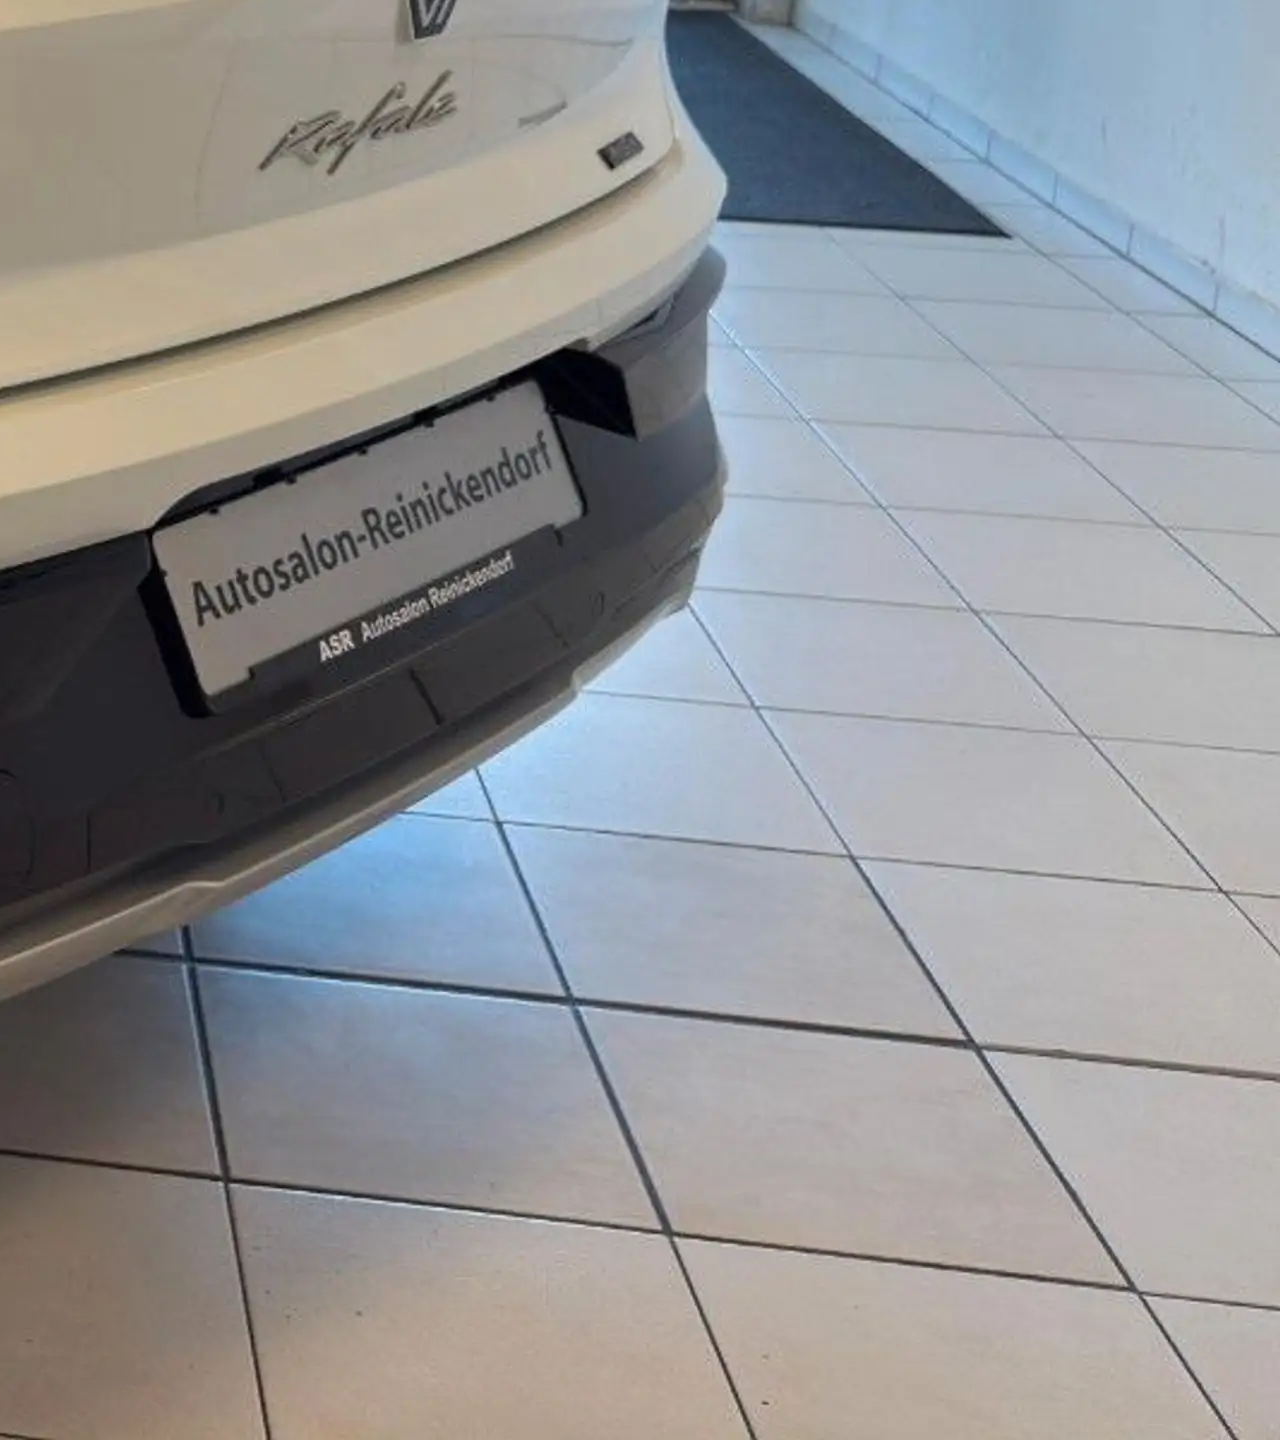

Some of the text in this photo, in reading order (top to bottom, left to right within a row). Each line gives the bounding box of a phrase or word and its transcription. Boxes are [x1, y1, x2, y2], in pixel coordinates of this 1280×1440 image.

[191, 431, 553, 627] Autosalon-Reinickendorf
[318, 552, 515, 663] ASR Autosalon Reinickendorf
